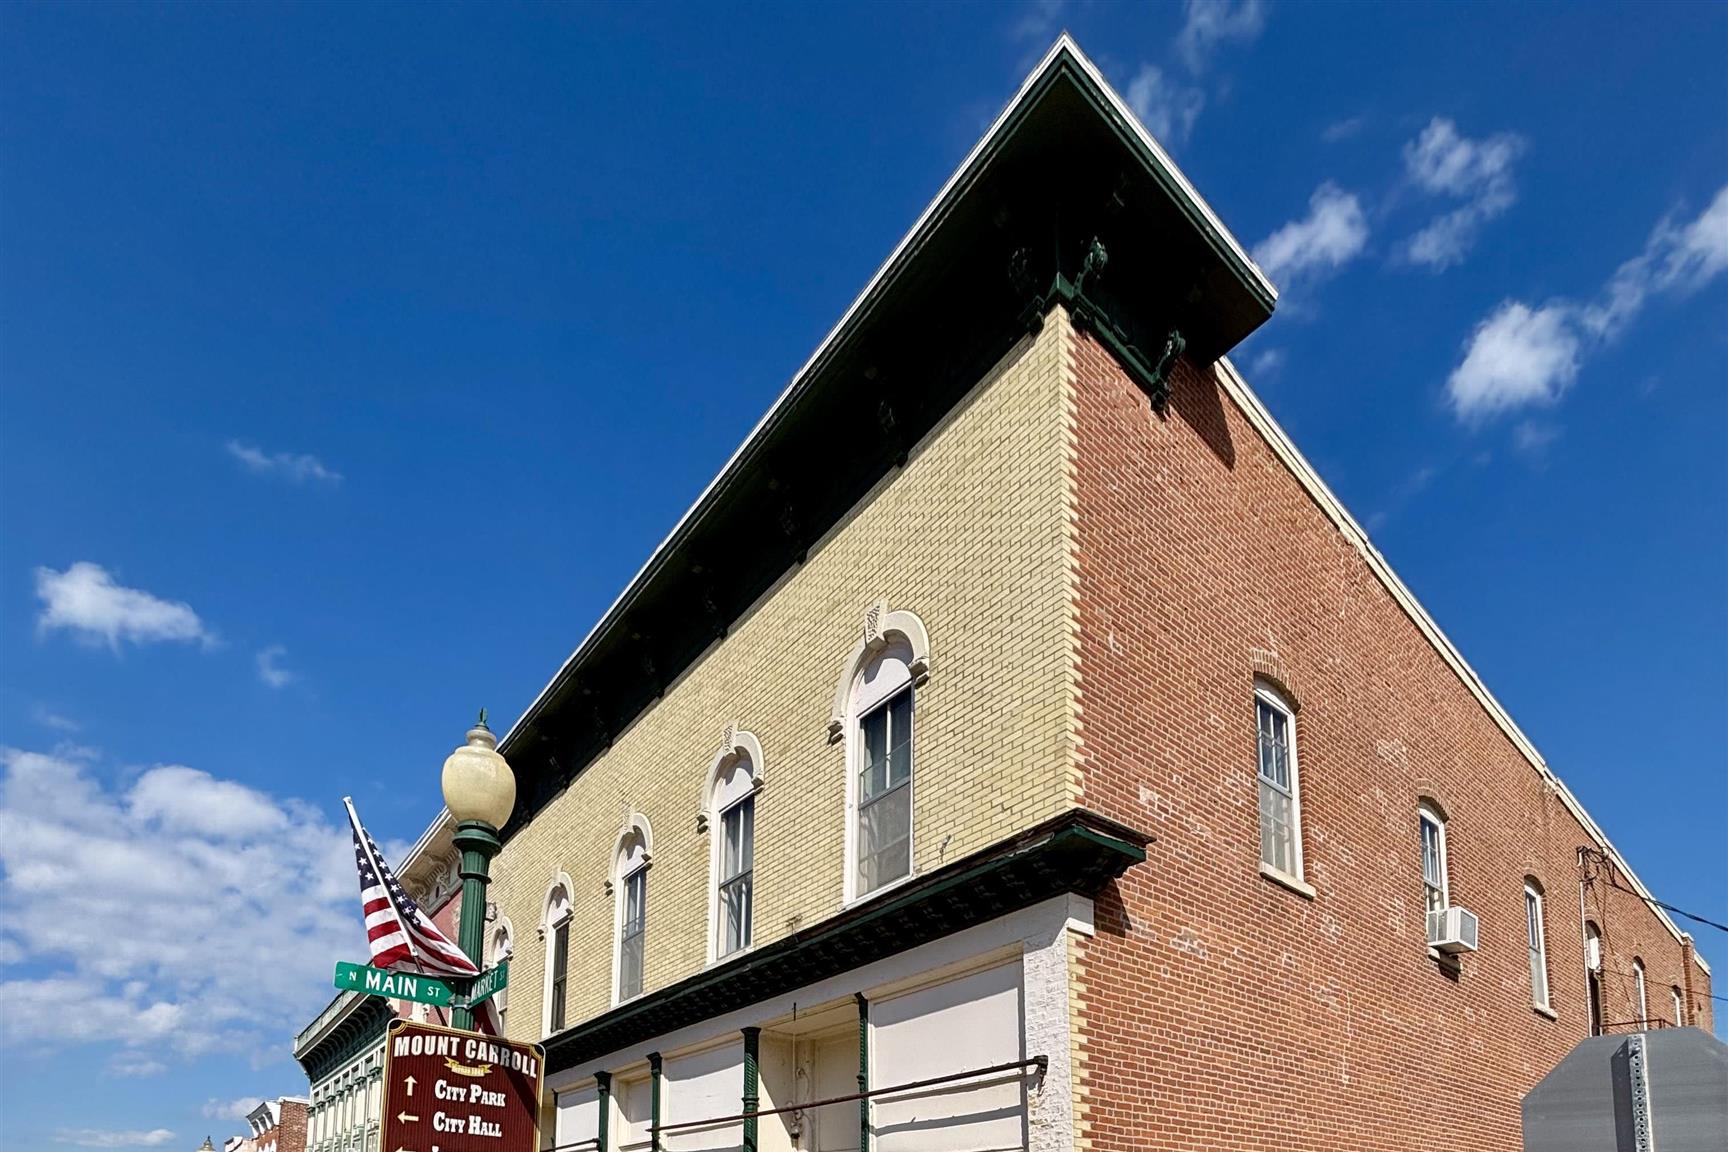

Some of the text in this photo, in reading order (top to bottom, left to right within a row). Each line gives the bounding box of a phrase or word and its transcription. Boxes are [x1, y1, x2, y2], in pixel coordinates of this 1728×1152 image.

[349, 970, 441, 998] N MAIN ST
[470, 970, 498, 1003] MARKET
[394, 1036, 537, 1078] MOUNT CARROLL
